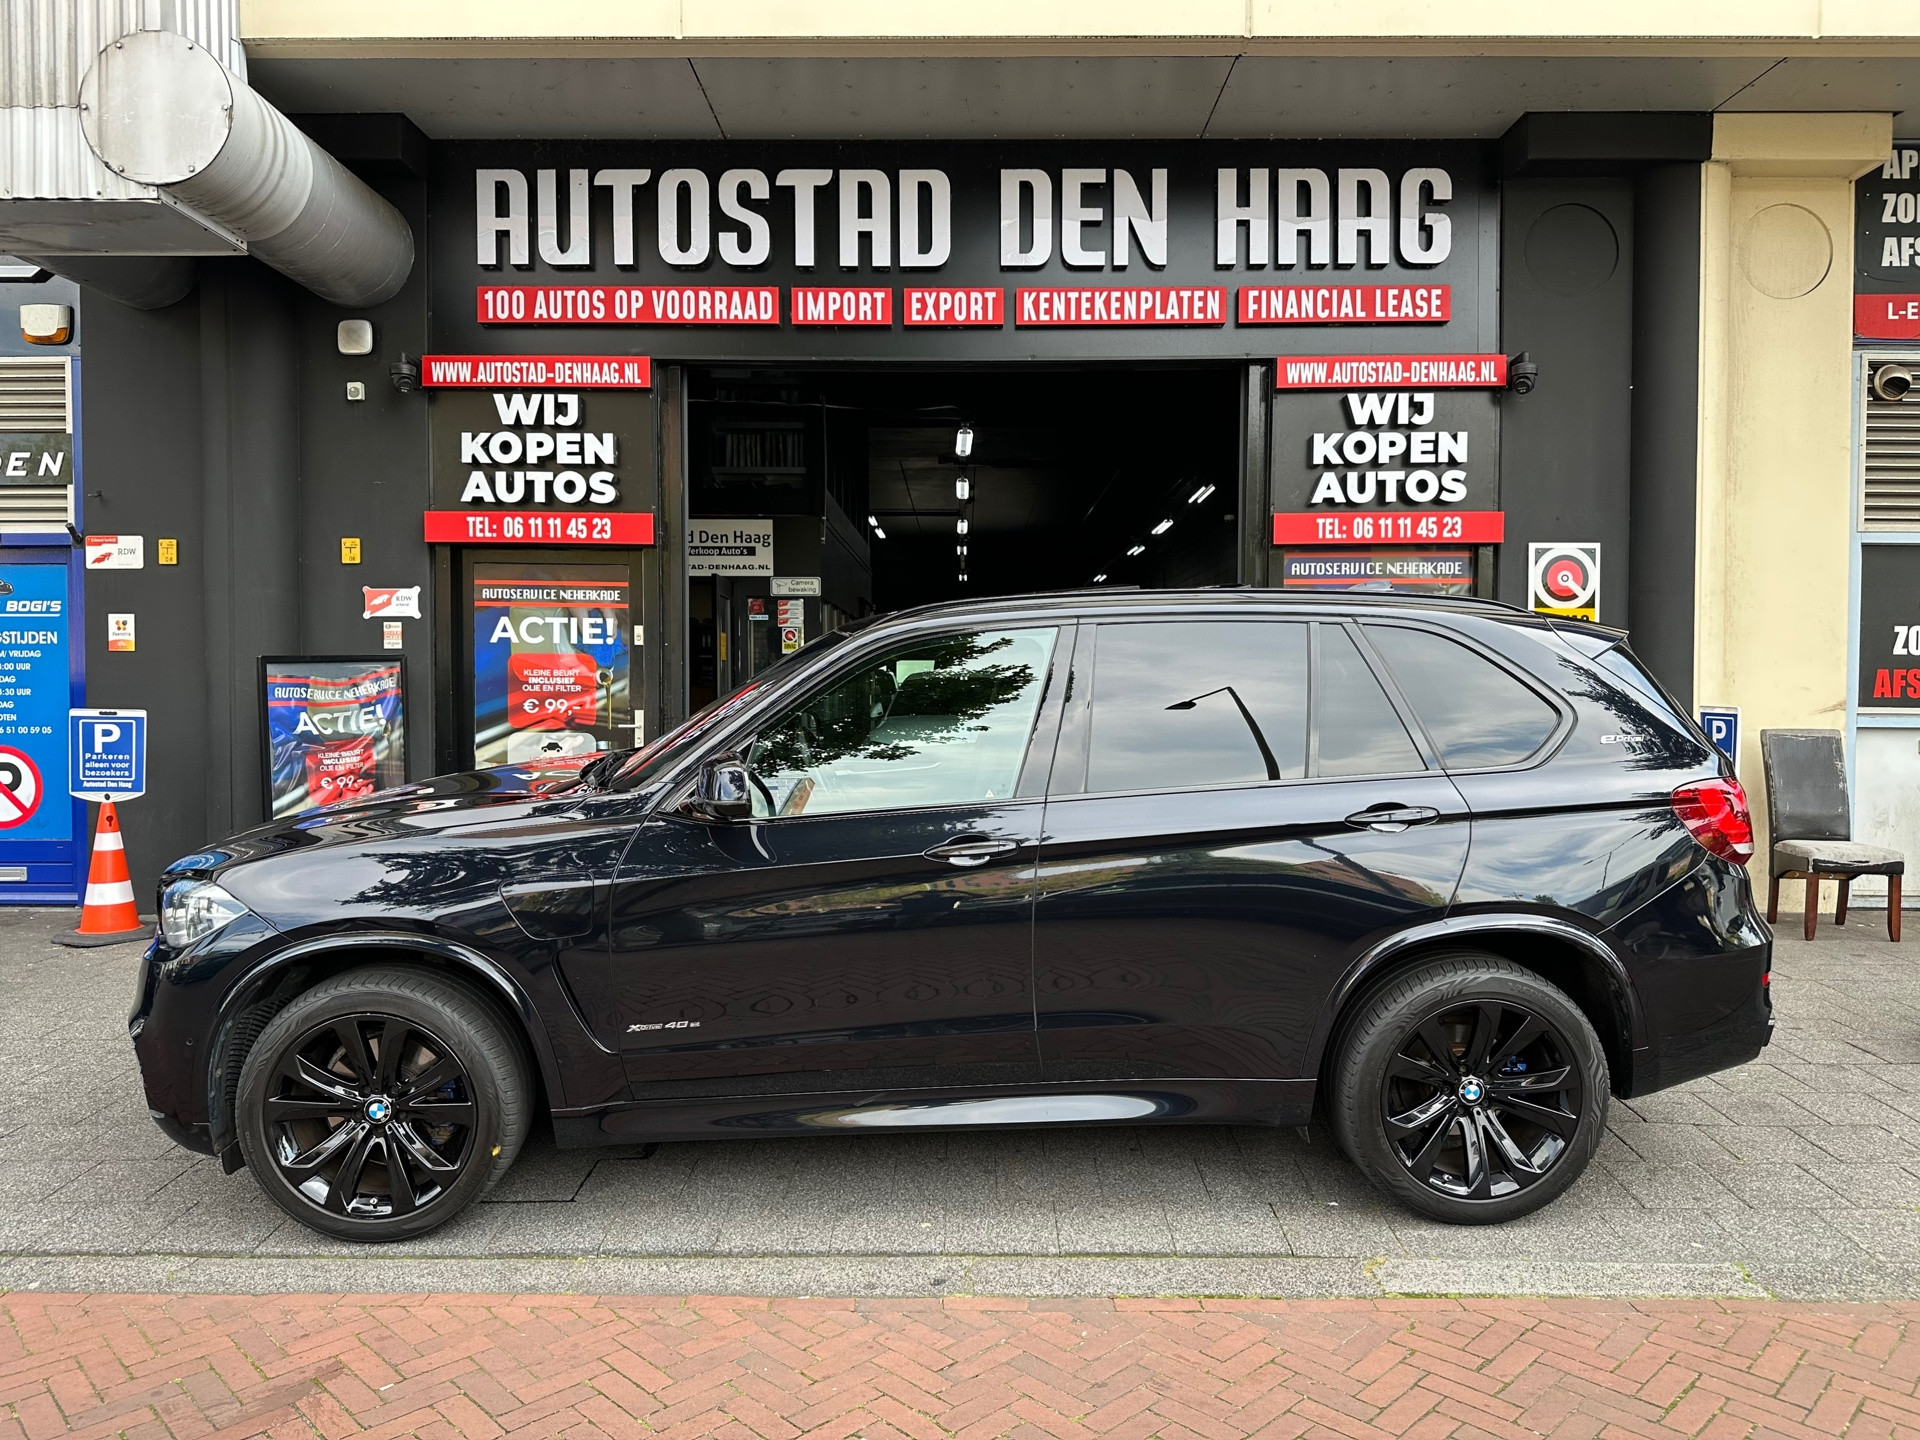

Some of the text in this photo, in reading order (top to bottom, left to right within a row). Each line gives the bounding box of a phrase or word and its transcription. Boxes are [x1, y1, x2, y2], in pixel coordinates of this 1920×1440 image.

[1882, 149, 1920, 179] AP
[476, 168, 1452, 267] AUTOSTAD DEN HAAG
[1882, 193, 1920, 223] ZO
[484, 290, 773, 321] 100 AUTOS OP VOORRAAD
[797, 291, 886, 321] IMPORT
[911, 291, 996, 321] EXPORT
[1022, 290, 1220, 321] KENTEKENPLATEN
[1247, 288, 1442, 320] FINANCIAL LEASE
[1887, 301, 1920, 320] L-E
[431, 361, 642, 384] WWW.AUTOSTAD-DENHAAG.NL
[1286, 361, 1498, 384] WWW.AUTOSTAD-DENHAAG.NL
[493, 393, 580, 426] WIJ
[1347, 392, 1435, 425] WIJ
[460, 431, 615, 464] KOPEN
[1312, 431, 1468, 465] KOPEN
[0, 451, 65, 477] EN
[460, 470, 617, 504] AUTOS
[1310, 469, 1468, 504] AUTOS
[466, 516, 612, 539] TEL: 06 11 11 45 23
[699, 530, 729, 544] Den
[733, 530, 771, 547] Haag
[1316, 516, 1462, 539] TEL: 06 11 11 45 23
[117, 547, 136, 556] RDW
[721, 547, 748, 556] Auto's
[1291, 561, 1463, 576] AUTOSERVICE NEHERKADE
[482, 588, 621, 601] AUTOSERVICE NEHERKADE
[788, 586, 817, 594] bewaking
[5, 600, 62, 612] BOGI'S
[0, 631, 58, 645] STIJDEN
[489, 616, 615, 645] ACTIE!
[8, 650, 42, 658] VRIJDAG
[16, 663, 31, 671] UUR
[523, 669, 580, 677] KLEINE BEURT
[16, 688, 31, 696] UUR
[274, 676, 396, 701] AUTOSERVICE NEHERKADE
[522, 698, 581, 716] € 99,-
[6, 726, 15, 734] 51
[18, 726, 28, 734] 00
[30, 726, 40, 734] 59
[42, 726, 52, 734] 05
[292, 704, 387, 735] ACTIE!
[94, 723, 121, 753] P
[1711, 720, 1727, 744] P
[84, 752, 130, 760] Parkeren
[85, 769, 130, 777] bezoekers
[320, 776, 334, 790] €
